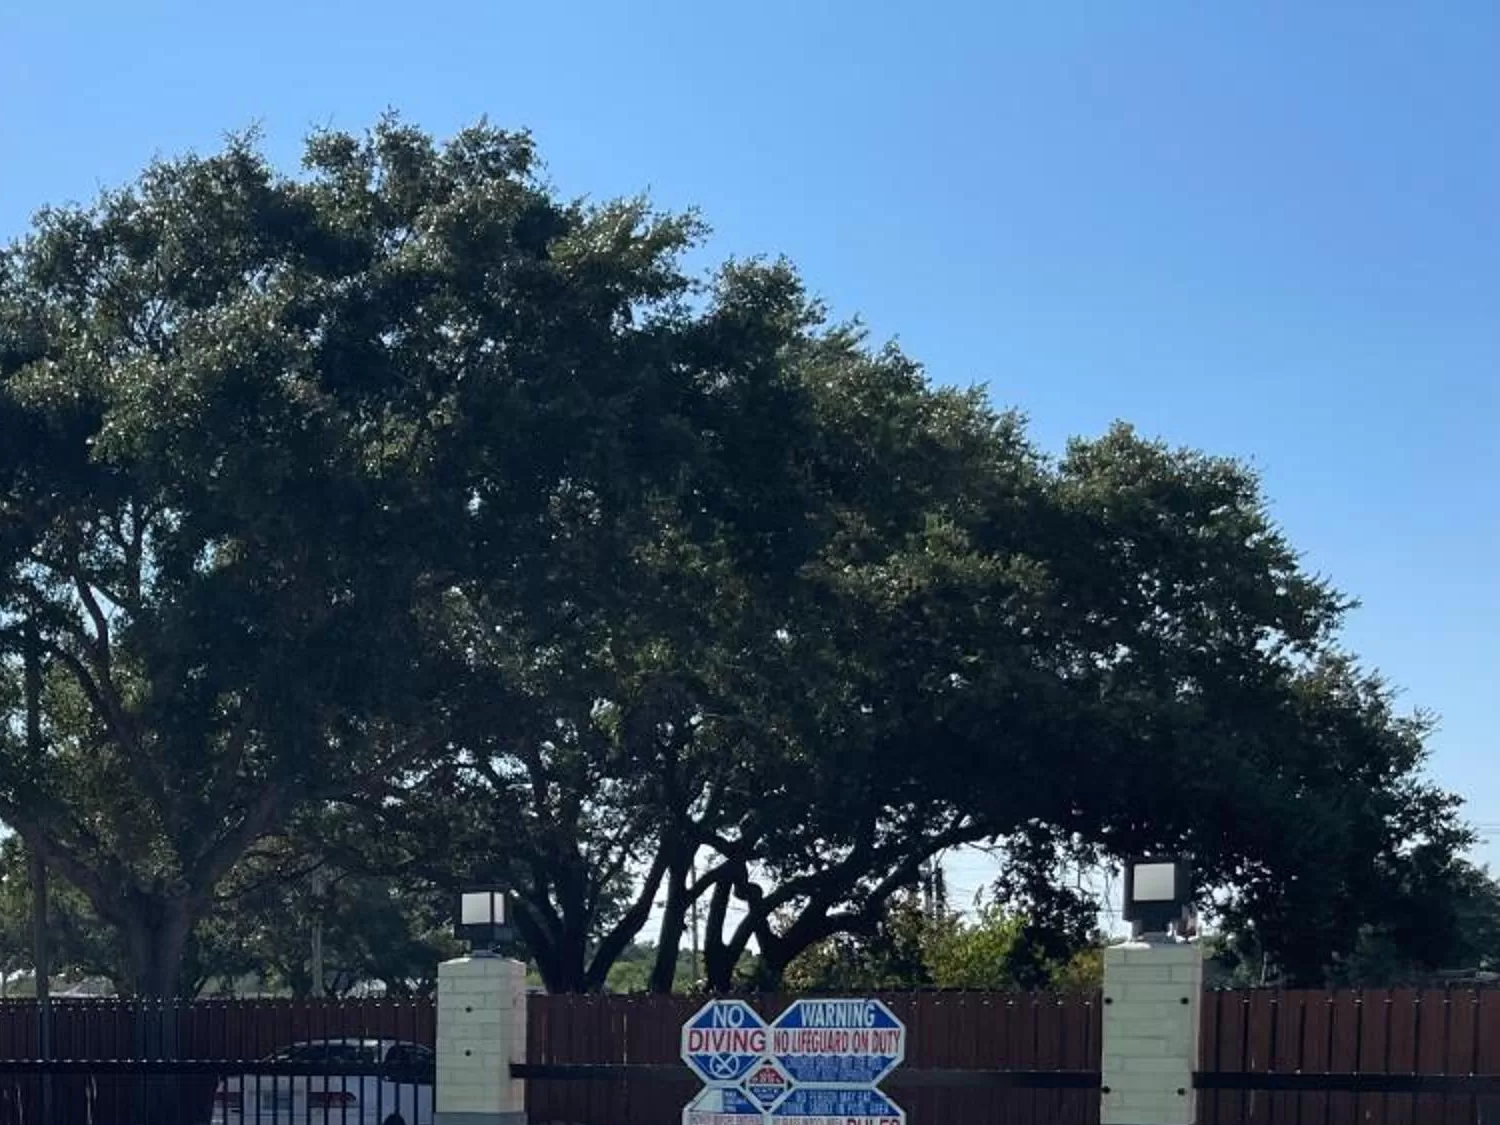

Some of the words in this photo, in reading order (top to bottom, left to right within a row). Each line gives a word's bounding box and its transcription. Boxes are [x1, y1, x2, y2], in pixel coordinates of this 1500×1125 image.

[712, 1005, 744, 1028] NO
[801, 1003, 876, 1027] WARNING
[688, 1030, 766, 1052] DIVING
[772, 1030, 789, 1053] NO
[791, 1030, 849, 1053] LIFEGUARD
[853, 1030, 869, 1053] ON
[871, 1030, 900, 1054] DUTY
